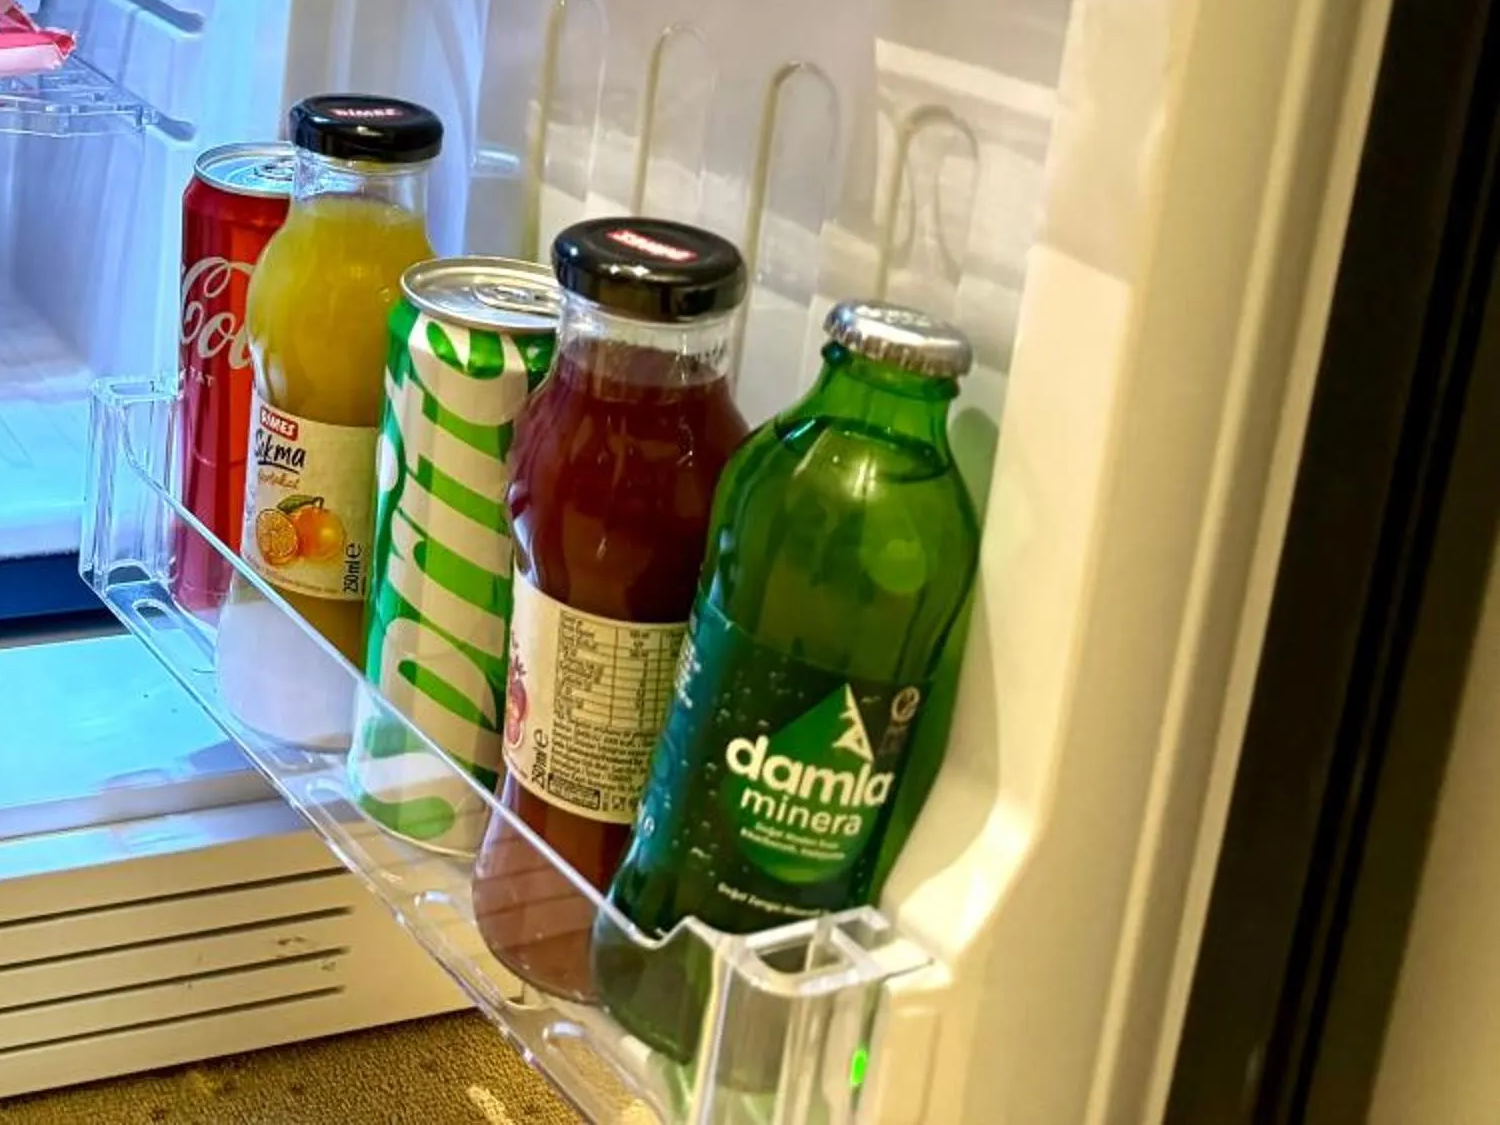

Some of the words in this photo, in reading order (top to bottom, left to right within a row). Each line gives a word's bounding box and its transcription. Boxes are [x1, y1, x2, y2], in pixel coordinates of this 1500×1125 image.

[352, 312, 528, 847] Sprite
[726, 735, 895, 807] damla
[741, 787, 863, 836] minera
